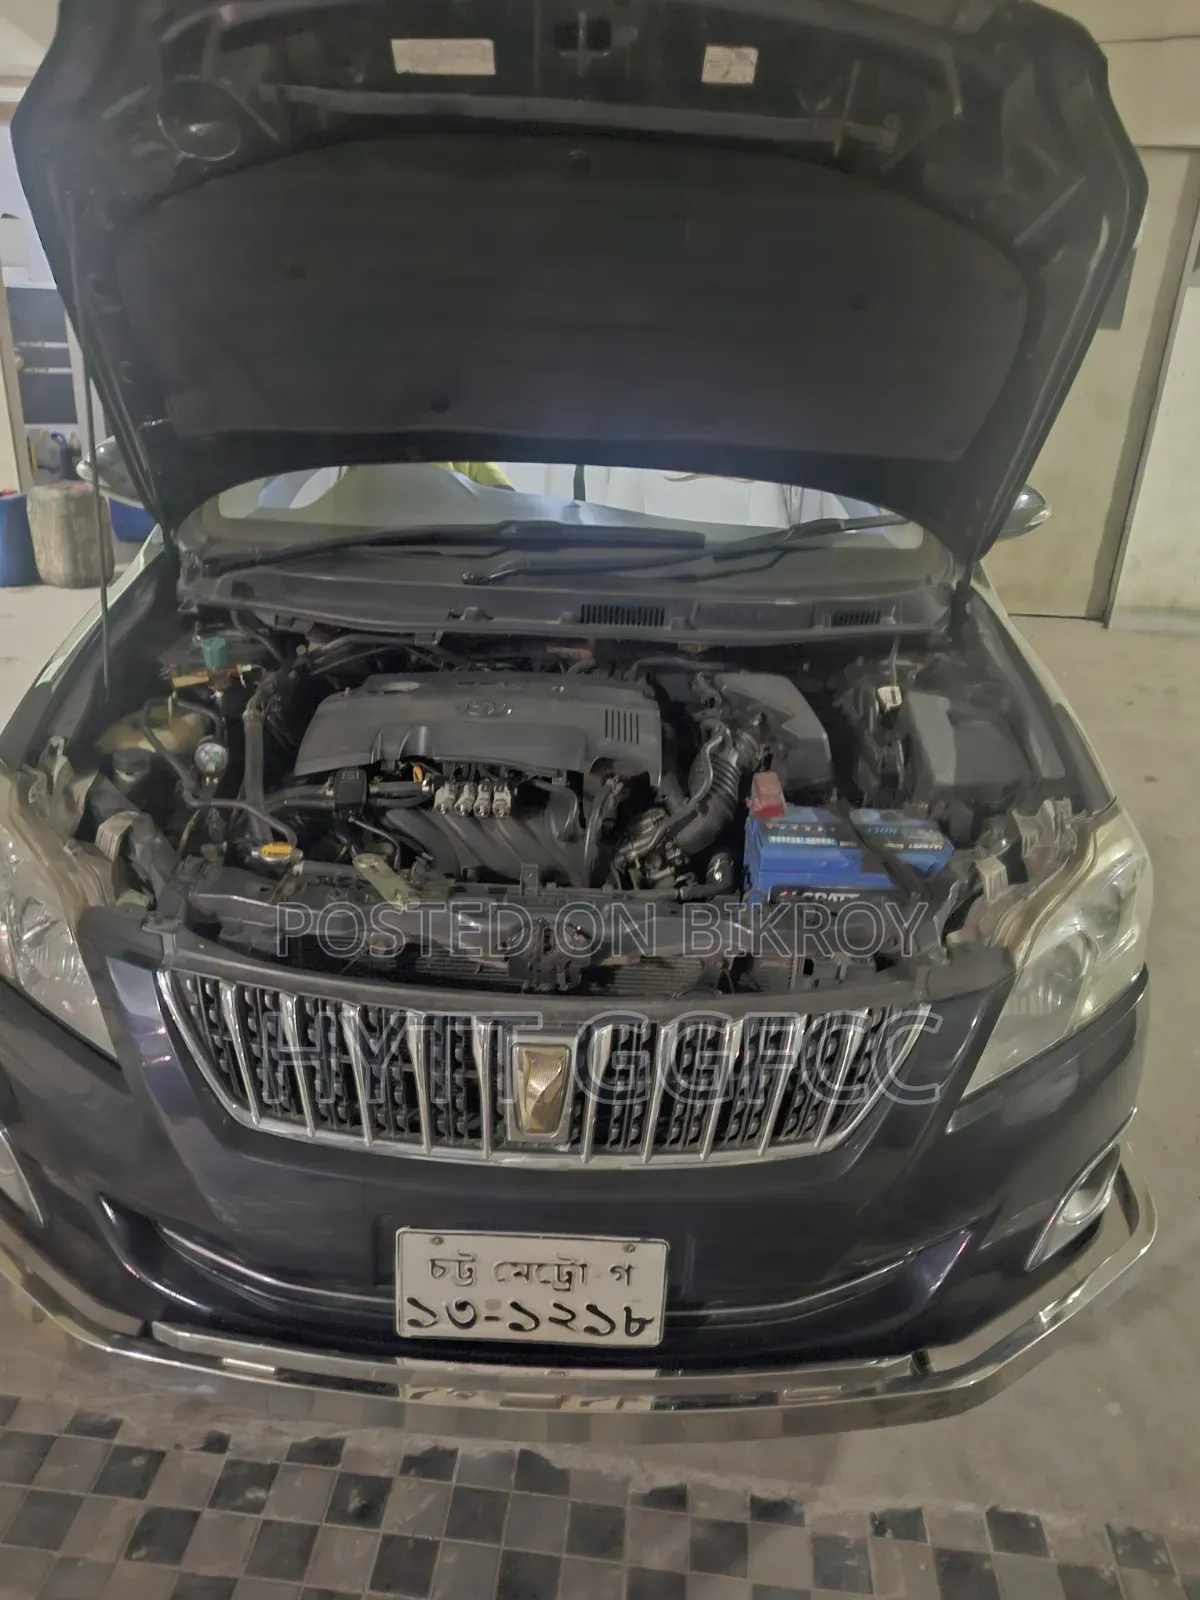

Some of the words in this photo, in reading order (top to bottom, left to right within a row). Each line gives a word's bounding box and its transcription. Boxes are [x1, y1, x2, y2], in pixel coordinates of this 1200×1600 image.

[428, 1248, 479, 1287] চট্ট
[491, 1252, 588, 1292] মেট্রো
[608, 1260, 634, 1286] গ
[405, 1296, 655, 1338] ১৩-১২১৮
